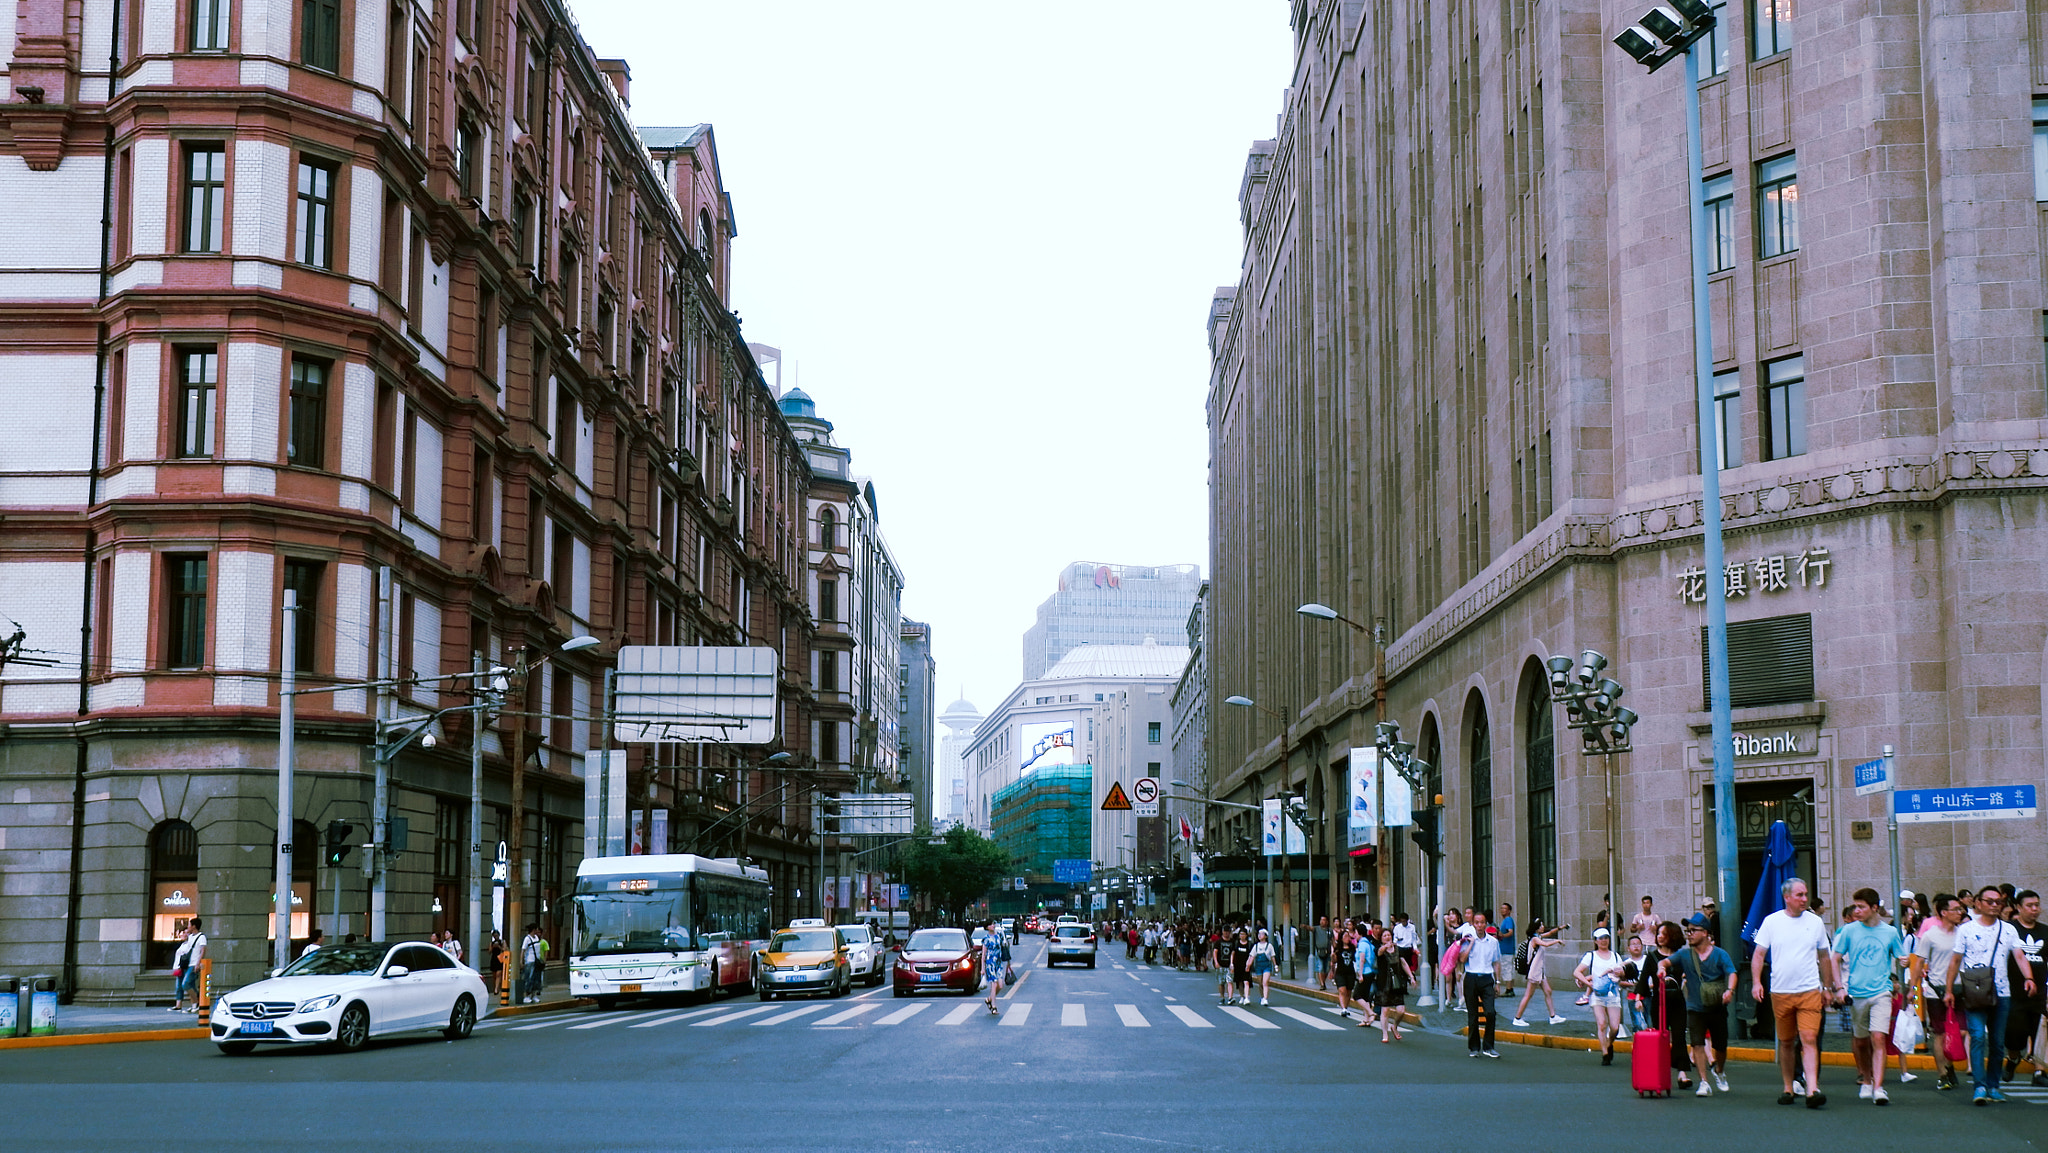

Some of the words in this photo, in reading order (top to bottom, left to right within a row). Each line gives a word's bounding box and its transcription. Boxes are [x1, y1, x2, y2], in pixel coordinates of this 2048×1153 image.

[1675, 548, 1831, 605] 花旗银行
[1733, 731, 1798, 757] tibank
[1911, 793, 1921, 804] 南
[1932, 791, 2005, 808] 中山东一路
[2014, 789, 2024, 799] 北
[163, 897, 191, 906] OMEGA
